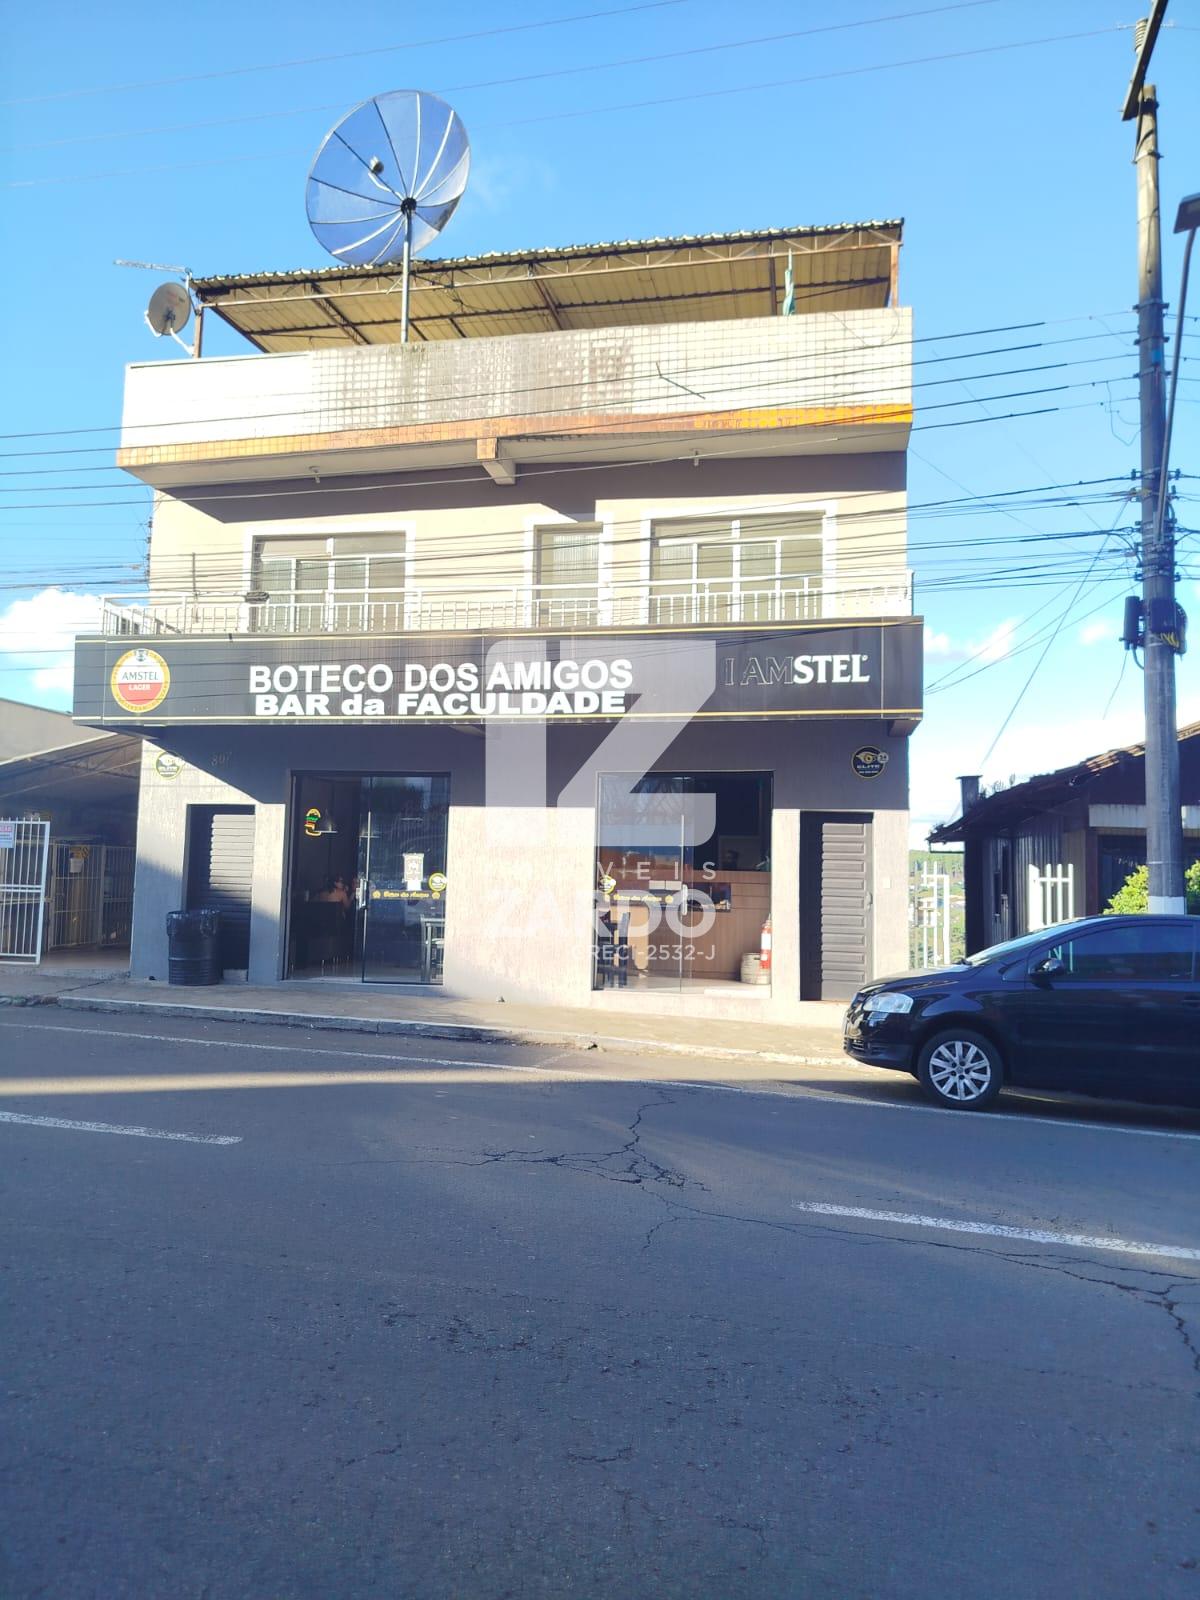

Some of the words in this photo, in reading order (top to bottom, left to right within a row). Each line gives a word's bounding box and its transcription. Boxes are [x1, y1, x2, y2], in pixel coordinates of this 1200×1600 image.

[121, 671, 159, 681] AMSTEL
[249, 663, 393, 693] BOTECO
[405, 662, 479, 692] DOS
[485, 659, 633, 690] AMIGOS
[724, 657, 735, 687] I
[741, 654, 871, 686] AMSTEL
[128, 684, 151, 692] LAGER
[255, 694, 331, 715] BAR
[341, 693, 386, 715] da
[398, 690, 626, 715] FACULDADE
